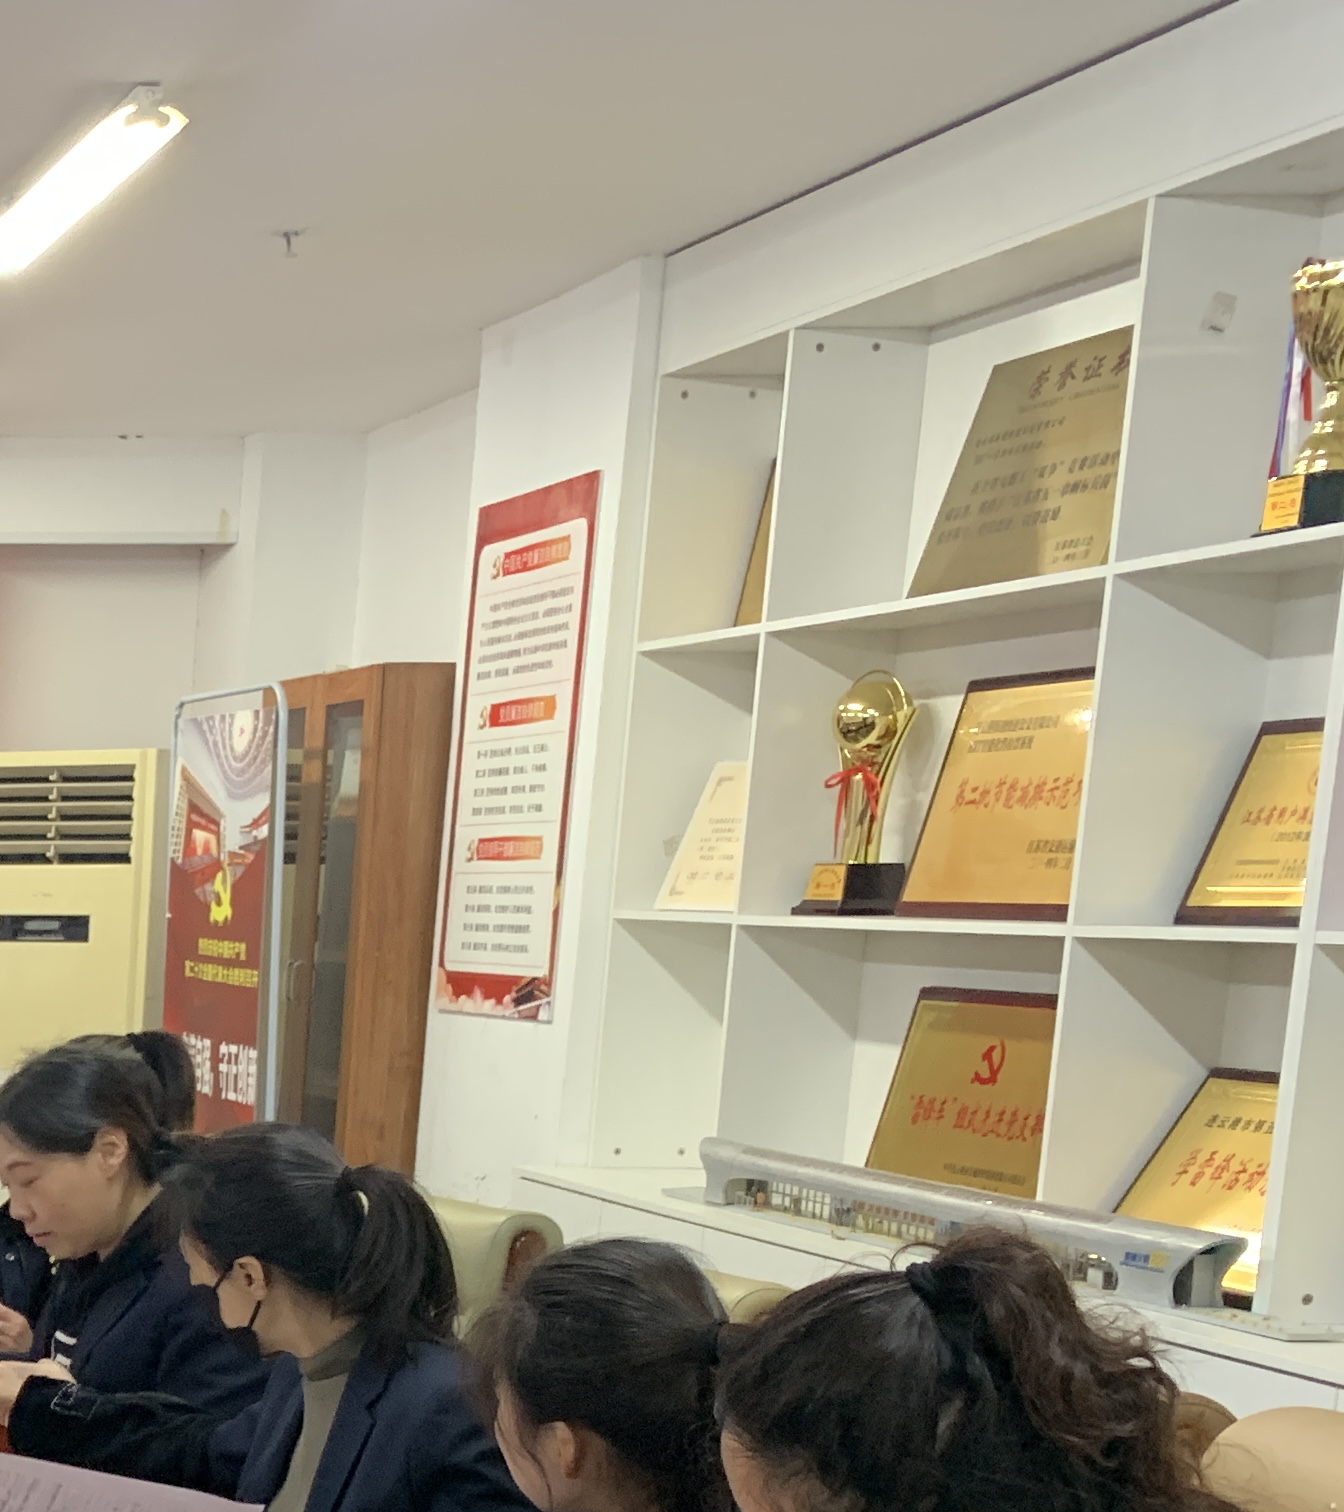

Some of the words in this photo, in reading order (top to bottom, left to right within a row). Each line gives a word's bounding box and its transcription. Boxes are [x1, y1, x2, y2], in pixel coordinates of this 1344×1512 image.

[1240, 803, 1314, 827] 江苏省用户满
[1170, 1148, 1269, 1197] 学雷锋活动
